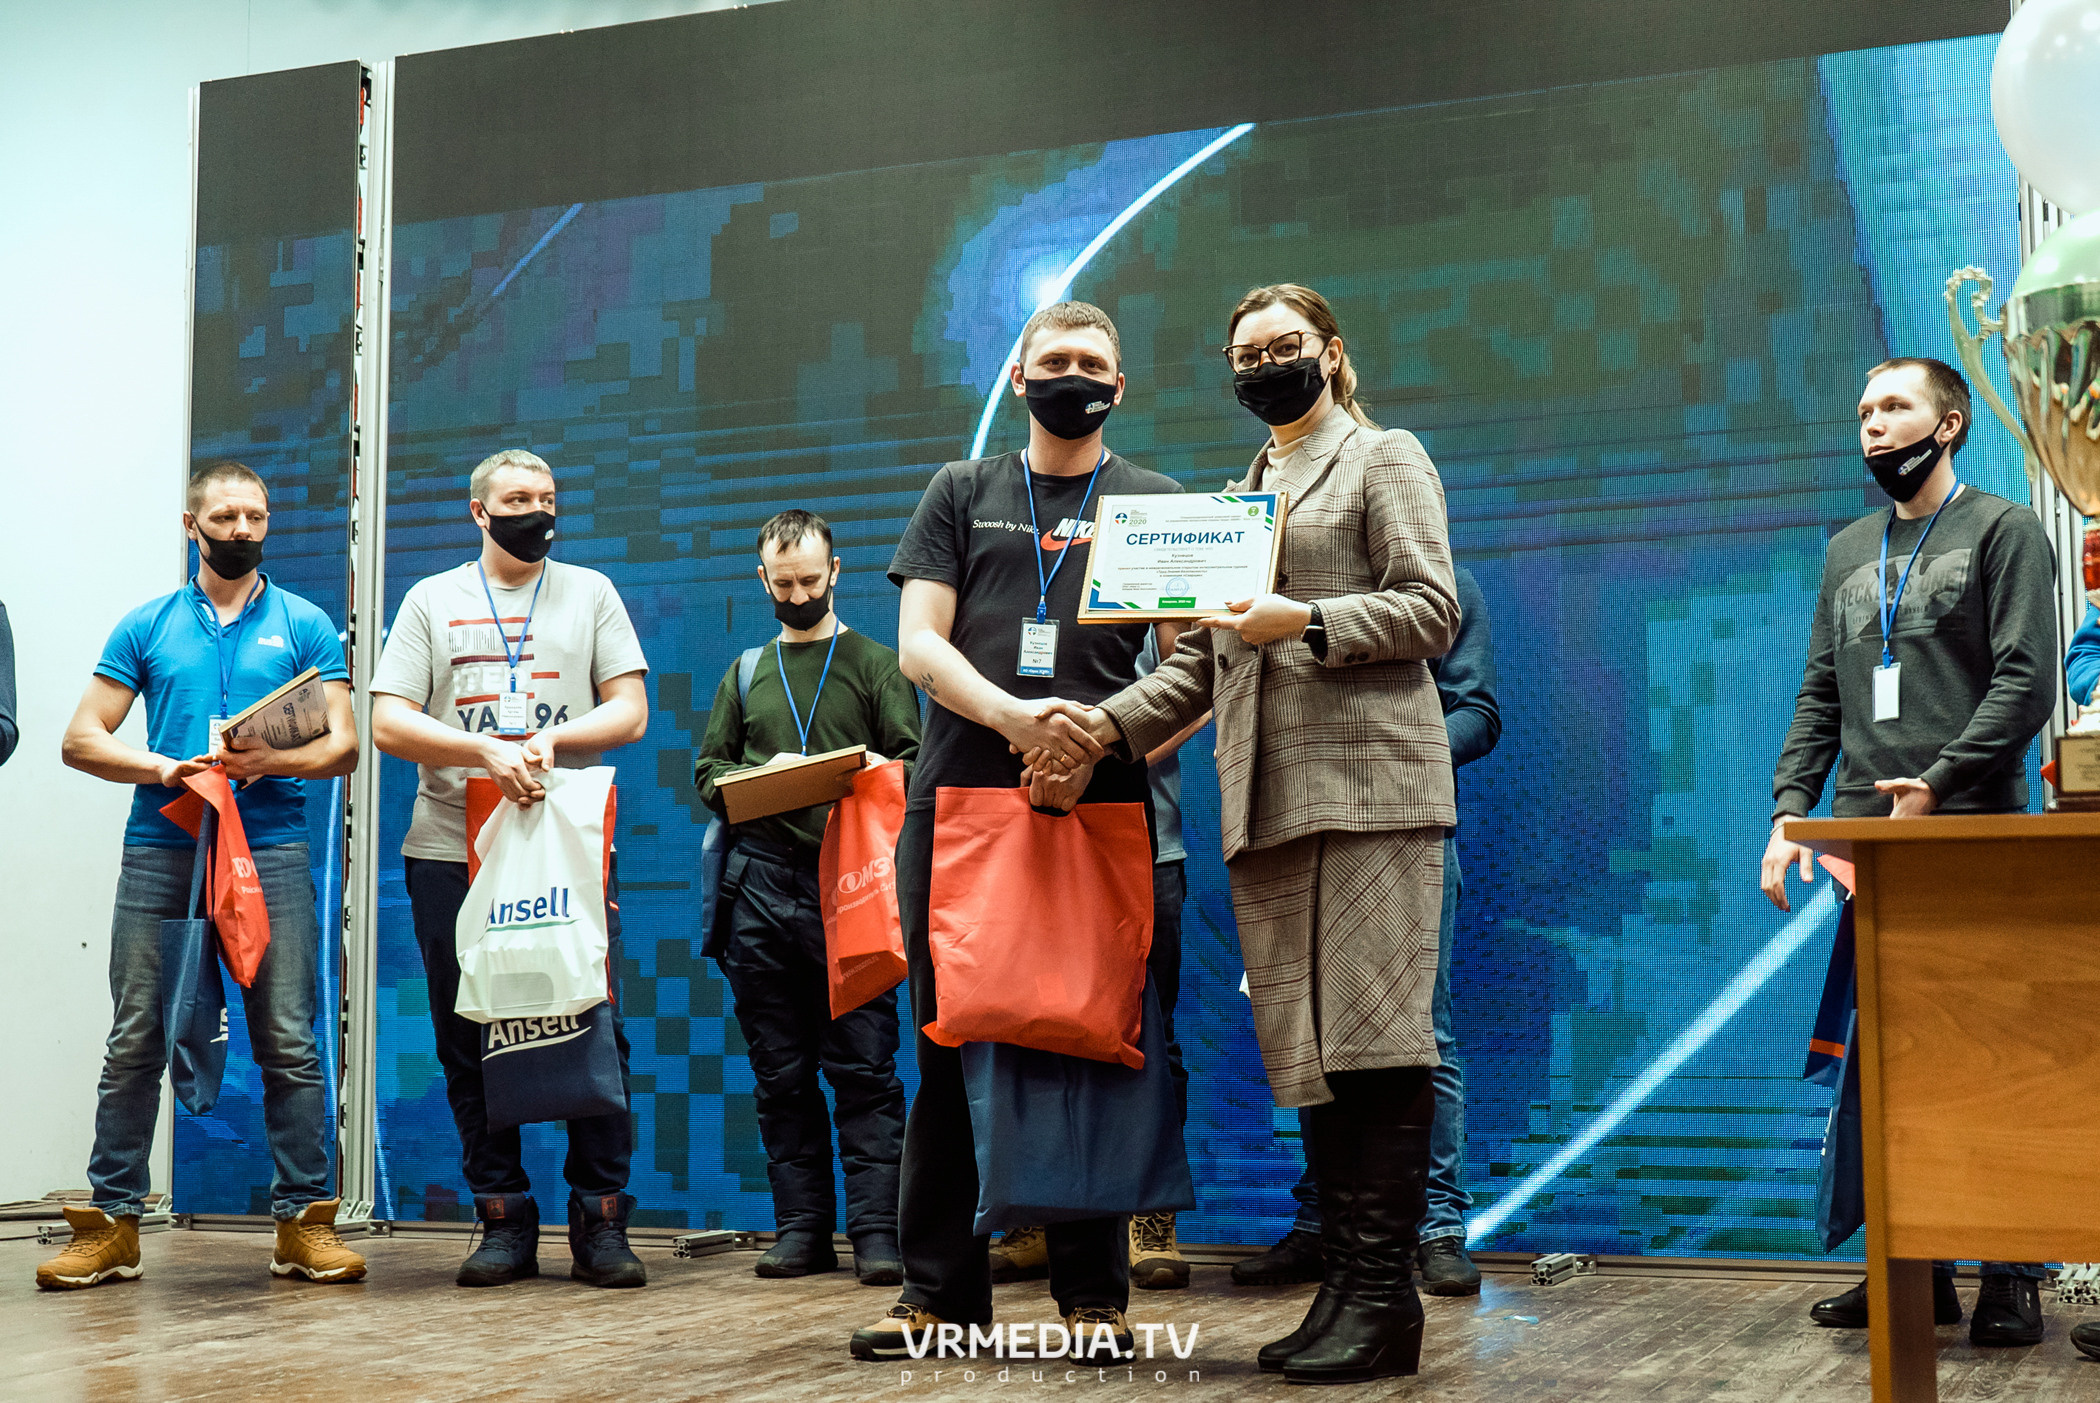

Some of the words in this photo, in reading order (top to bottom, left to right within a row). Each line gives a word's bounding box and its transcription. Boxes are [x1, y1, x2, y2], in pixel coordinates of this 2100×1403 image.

[972, 519, 1004, 529] Swoosh
[1005, 521, 1017, 532] by
[1126, 531, 1245, 546] СЕРТИФИКАТ
[486, 886, 570, 927] Ansell
